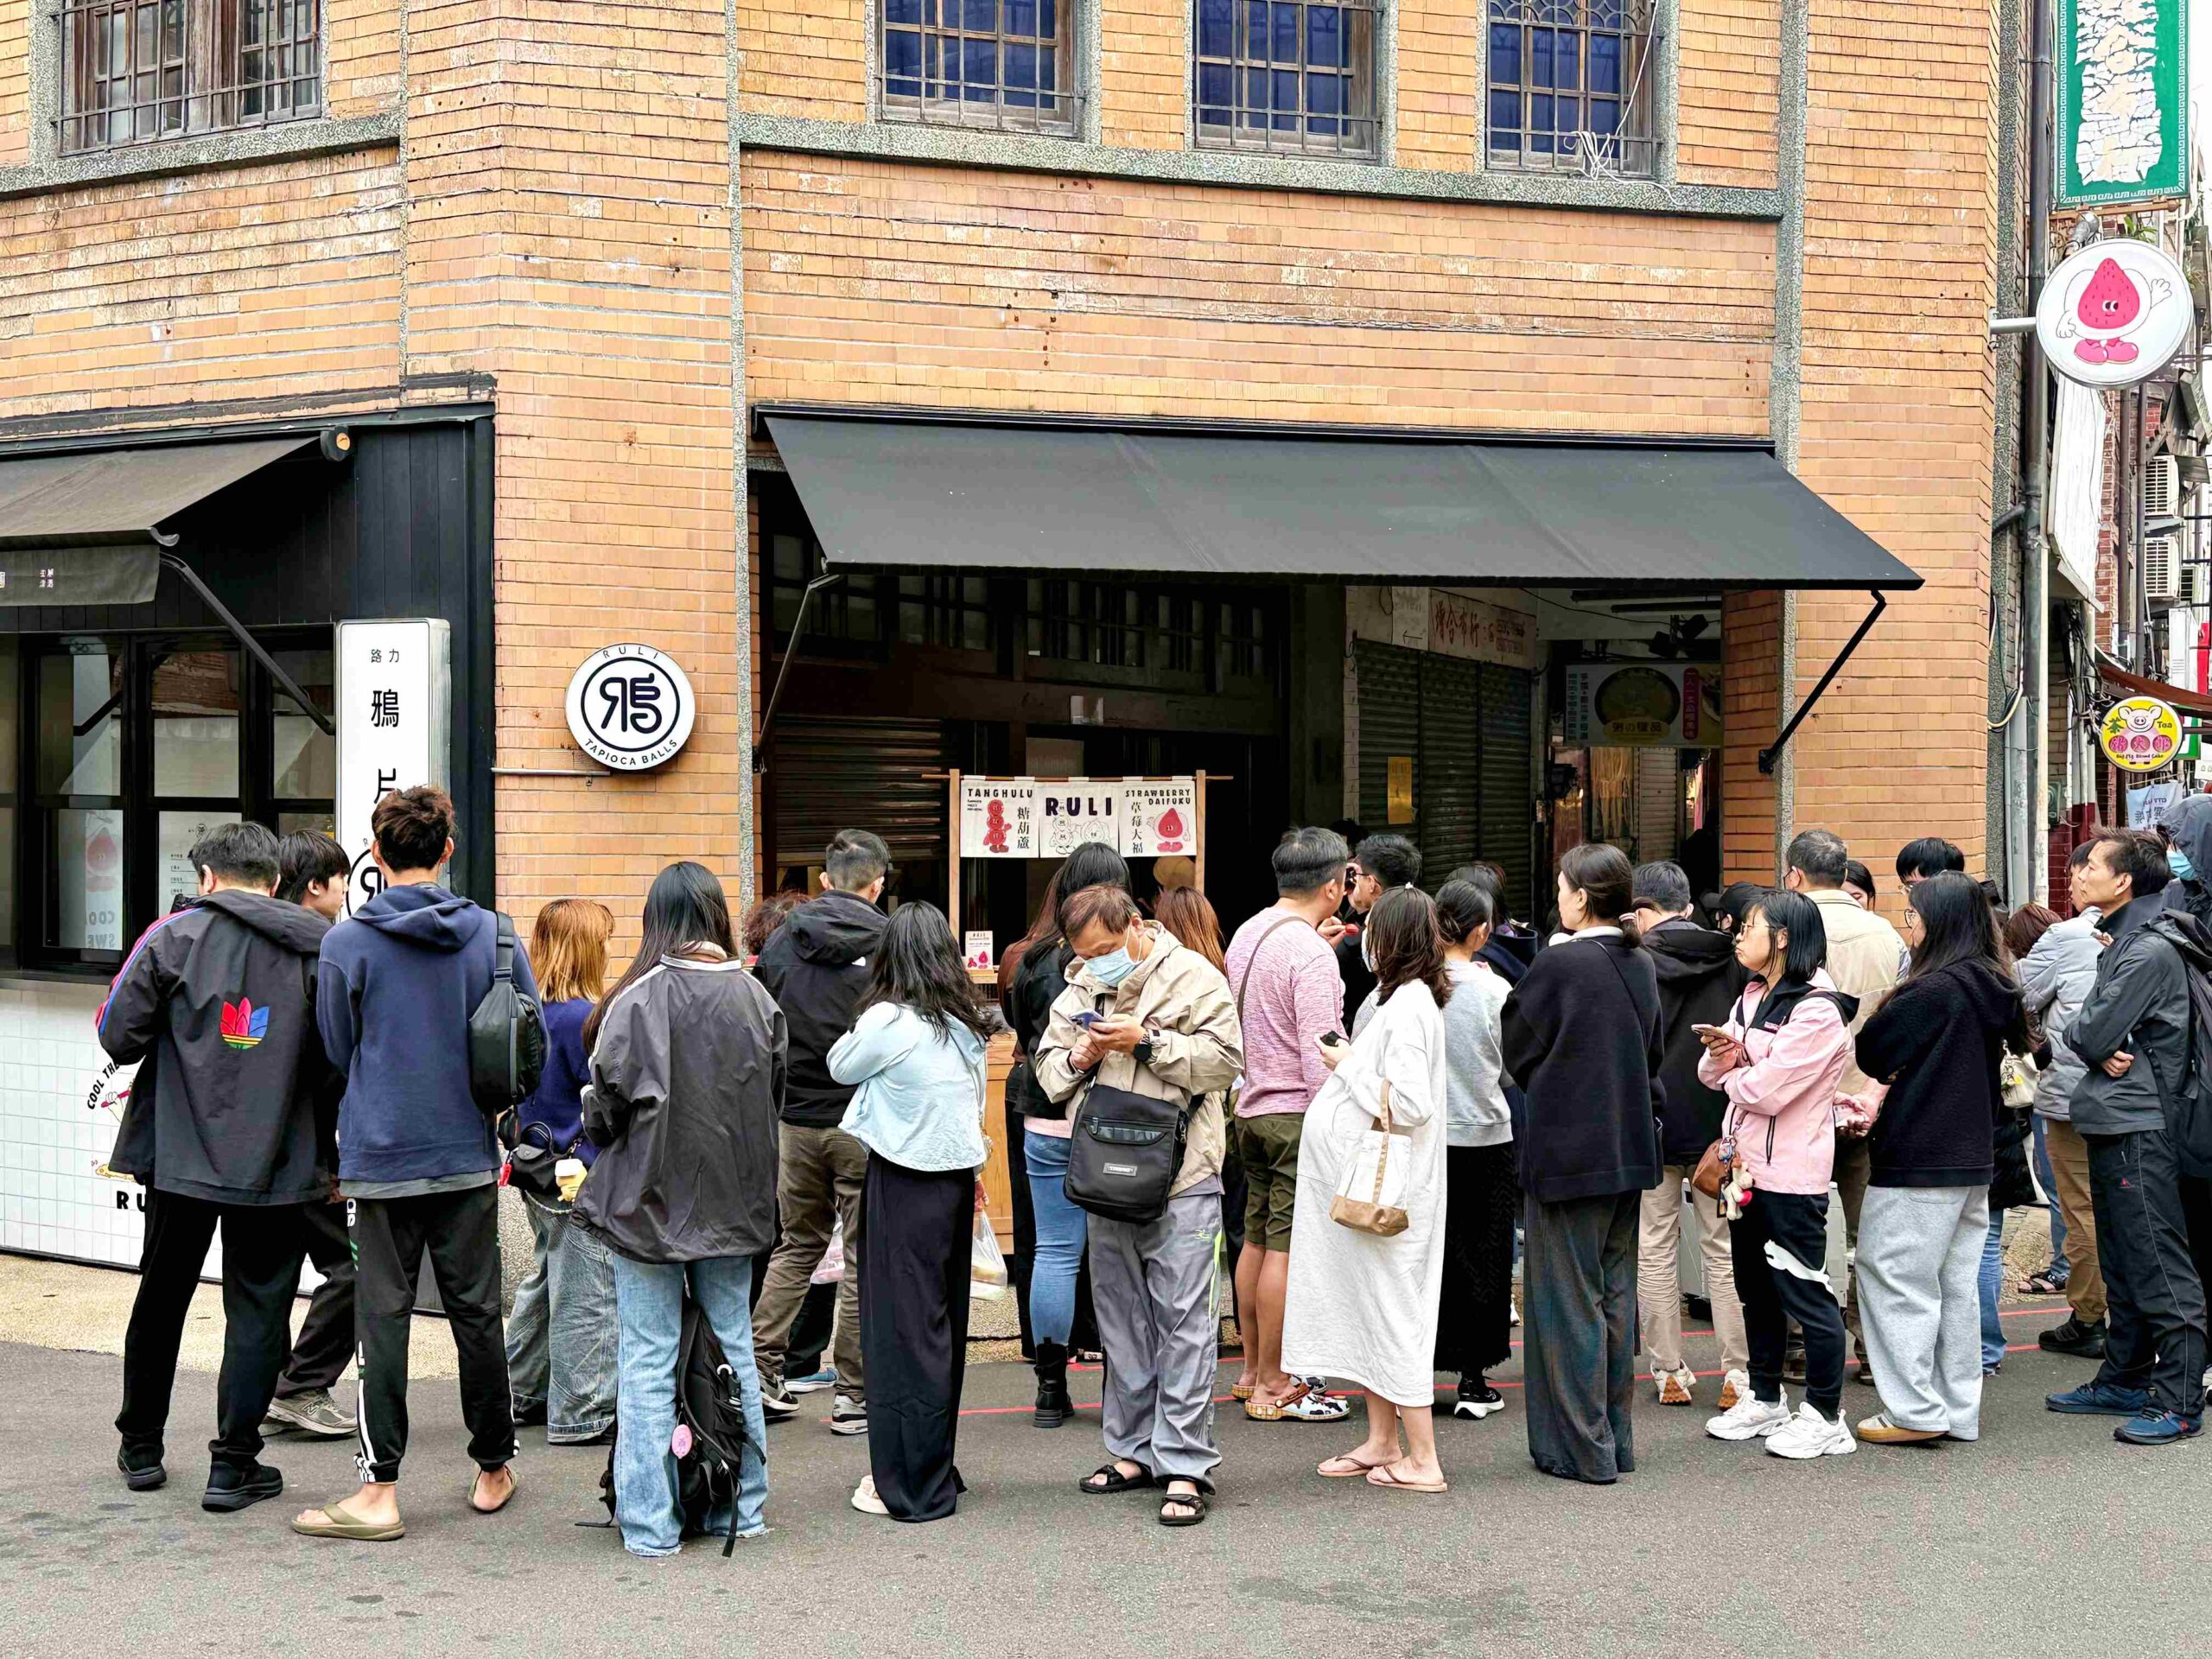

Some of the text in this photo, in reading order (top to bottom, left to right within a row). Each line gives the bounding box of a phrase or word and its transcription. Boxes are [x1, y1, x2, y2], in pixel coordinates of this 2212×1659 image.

[371, 648, 399, 663] 路力
[603, 646, 658, 659] RULI
[585, 738, 677, 766] TAPIOCA BALLS
[968, 788, 1033, 798] TANGHULU
[1125, 788, 1191, 798] STRAWBERRY
[1046, 797, 1112, 817] RULI
[87, 1079, 105, 1109] COOL
